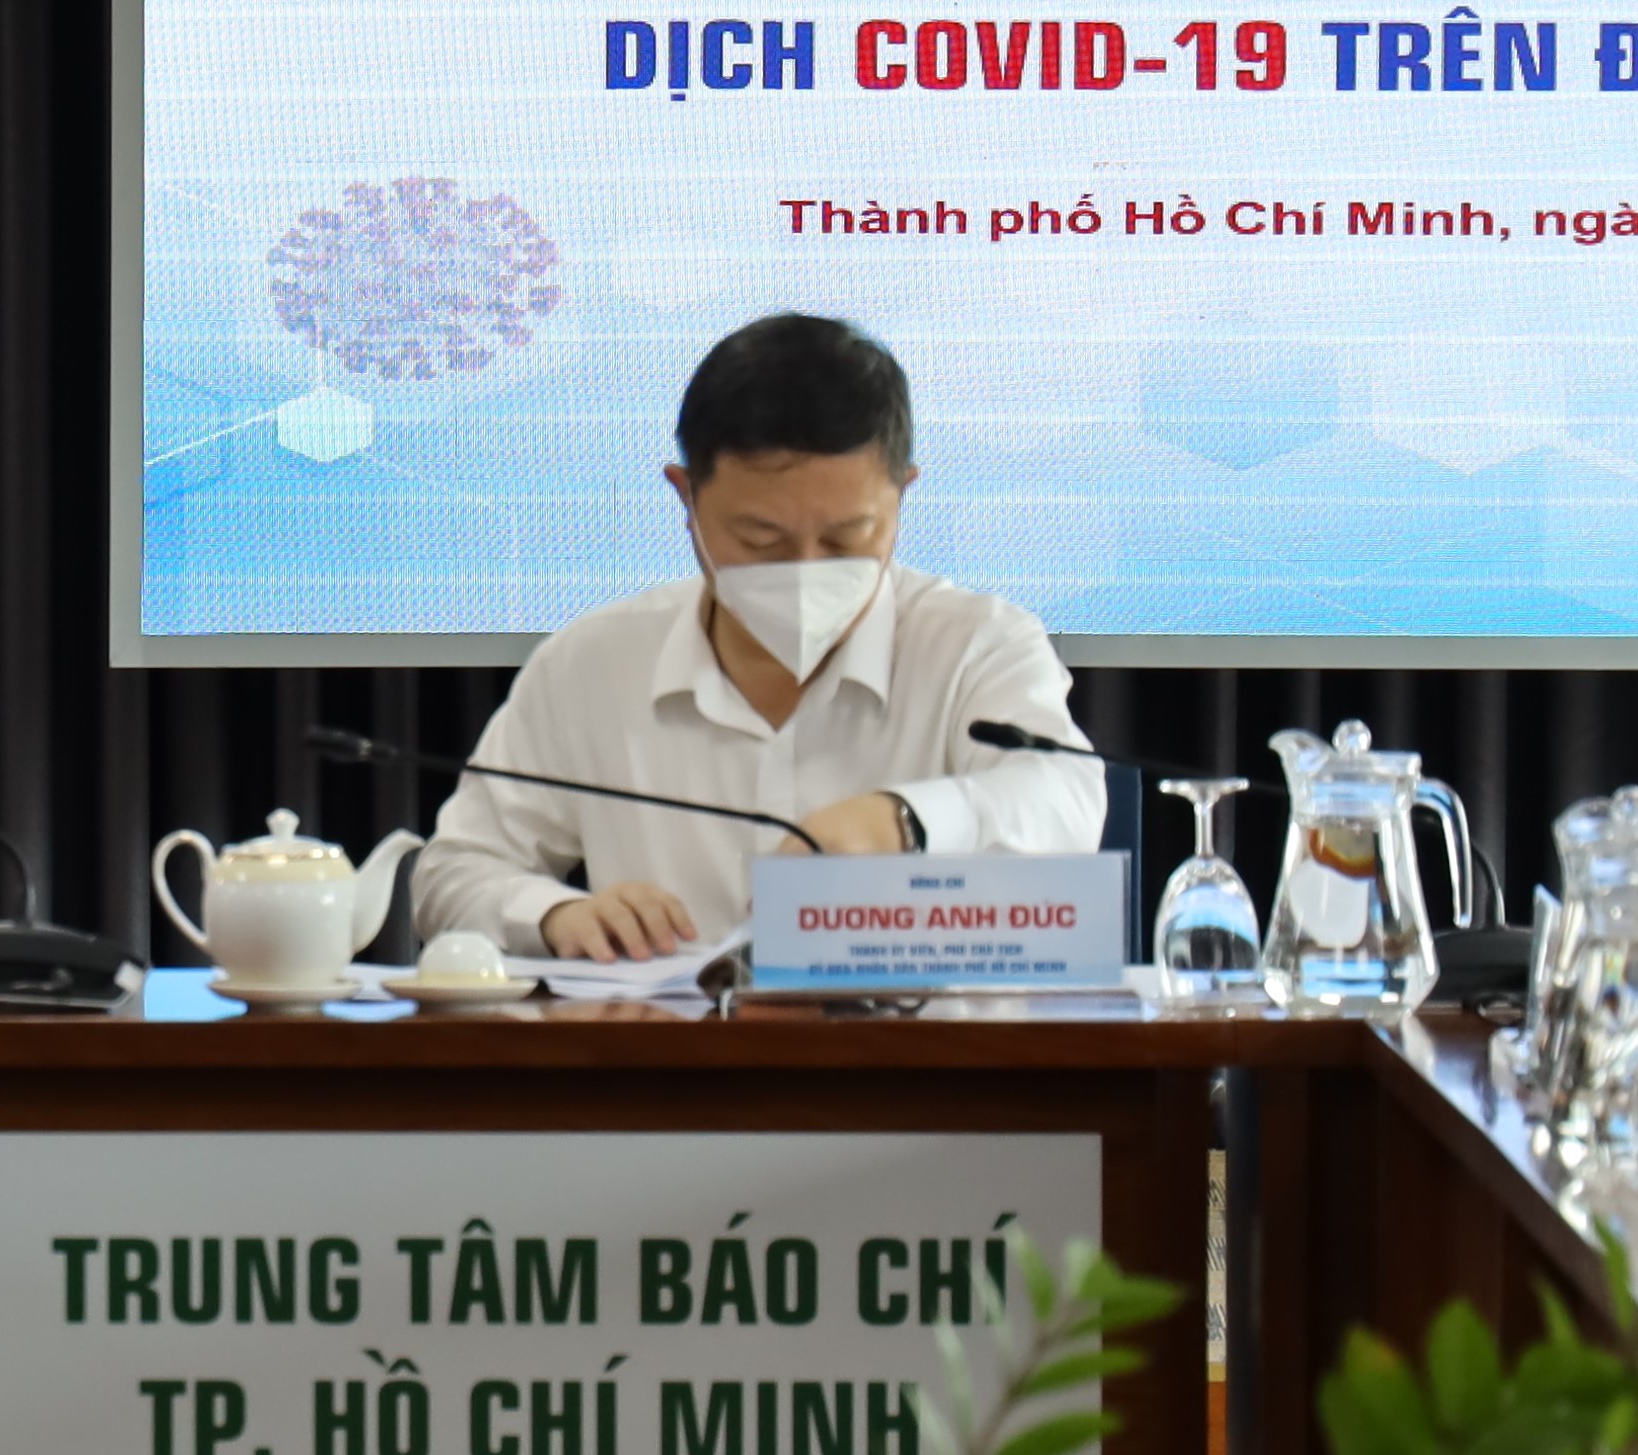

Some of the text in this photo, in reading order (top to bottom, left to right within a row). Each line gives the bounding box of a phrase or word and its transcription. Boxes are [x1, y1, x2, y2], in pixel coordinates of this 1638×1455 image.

[604, 19, 815, 102] DỊCH
[855, 18, 1288, 92] COVID-19
[1320, 6, 1558, 92] TRÊN
[779, 199, 967, 234] Thành
[991, 194, 1102, 242] phố
[1125, 194, 1206, 235] Hồ
[1226, 201, 1325, 235] Chí
[1348, 200, 1510, 241] Minh,
[926, 904, 998, 930] ANH
[52, 1211, 1017, 1327] TRUNG TÂM BÁO CHÍ
